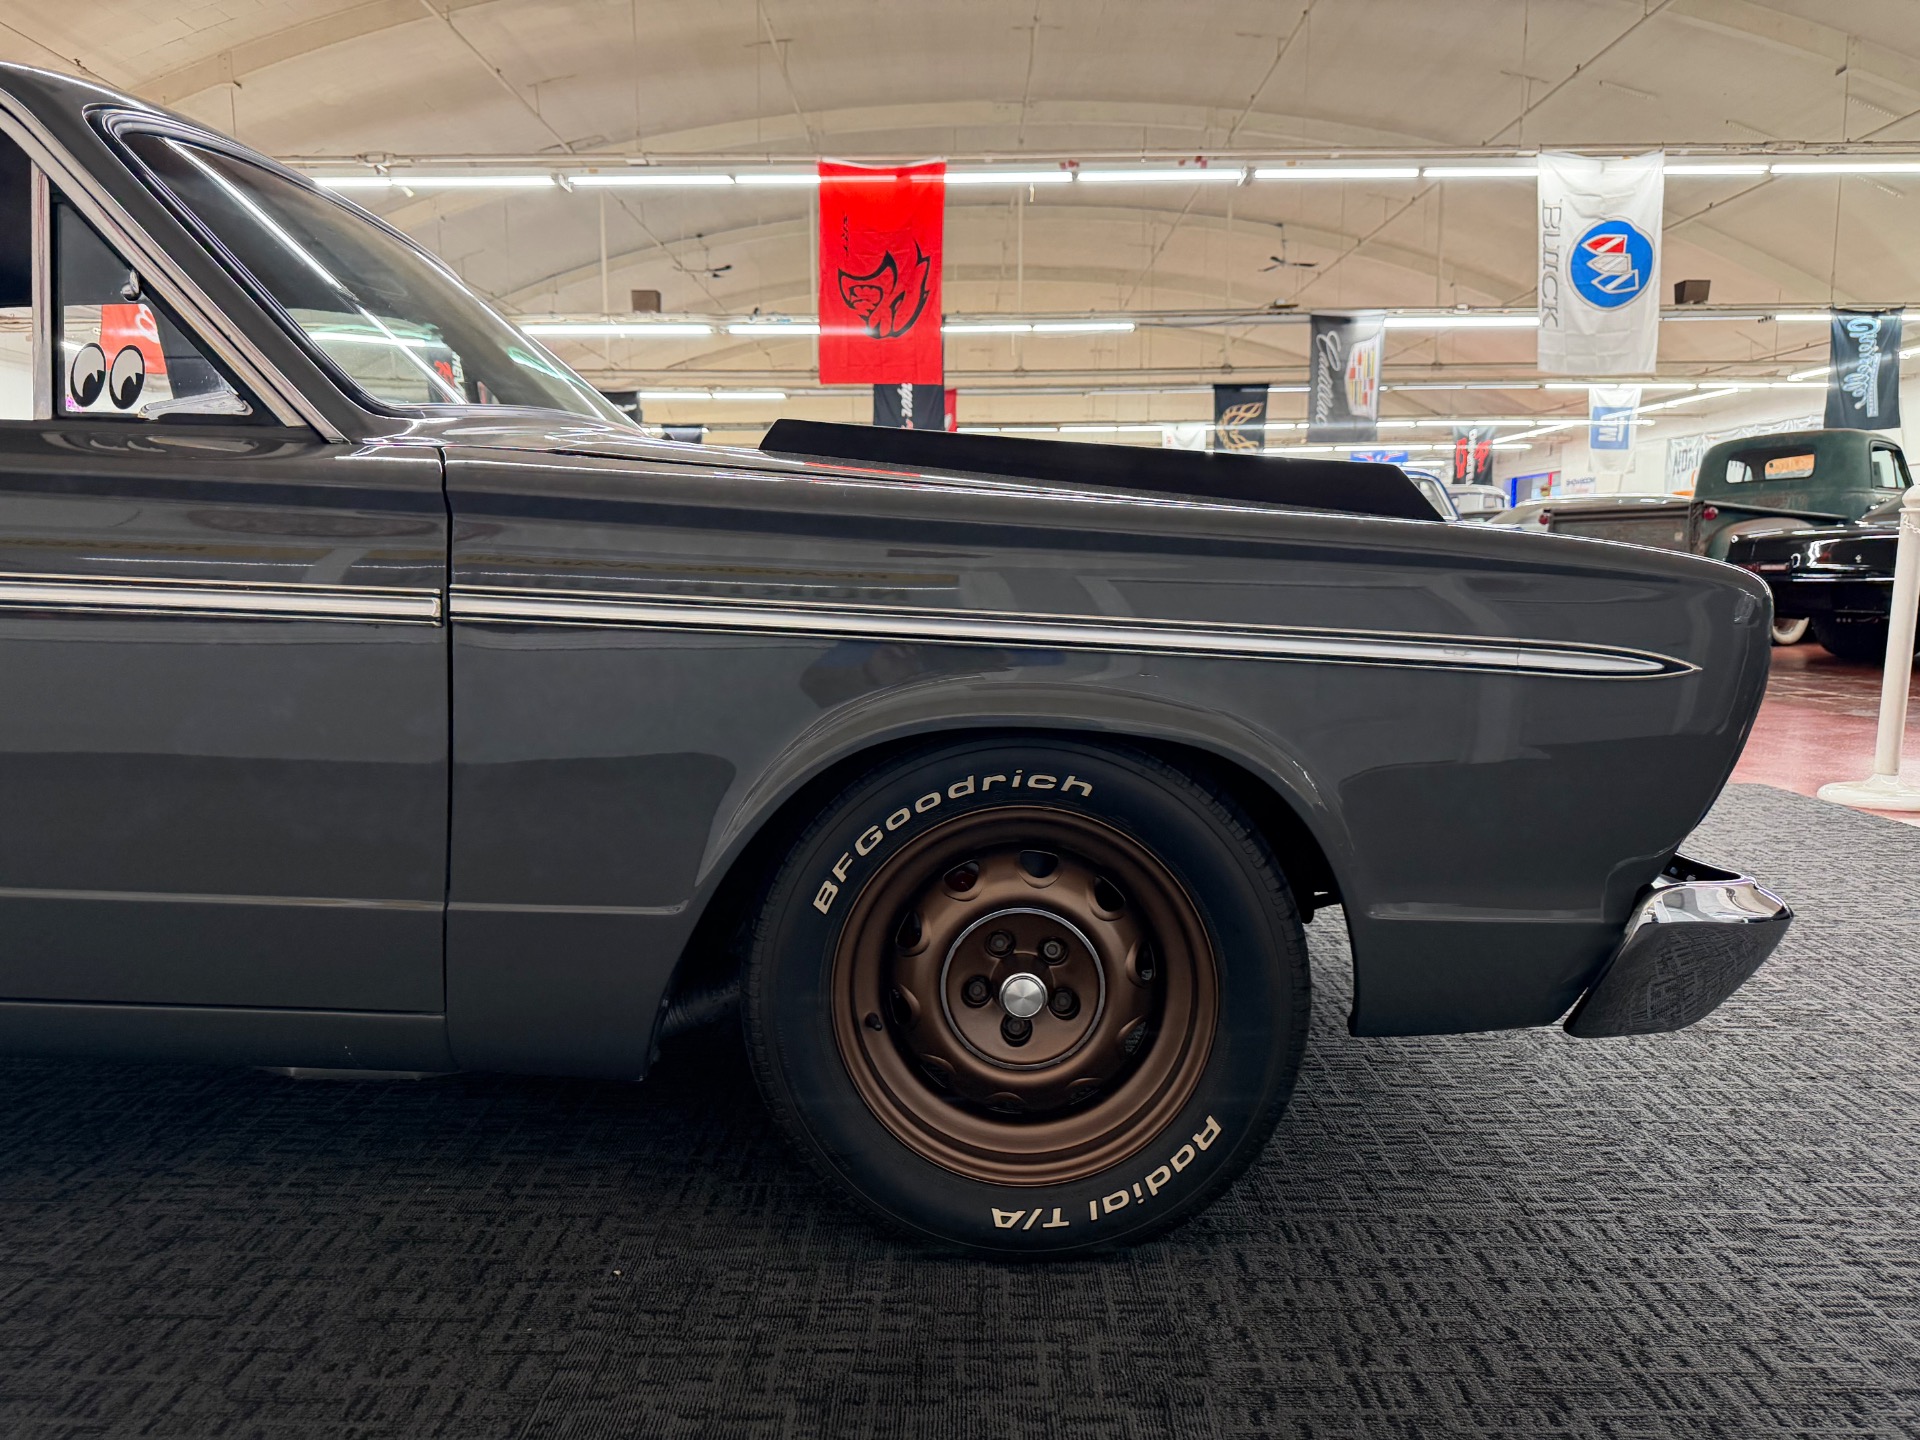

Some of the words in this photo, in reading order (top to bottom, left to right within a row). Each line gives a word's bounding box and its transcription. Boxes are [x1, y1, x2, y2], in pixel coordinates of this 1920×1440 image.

[1541, 198, 1562, 328] BUICK
[1315, 330, 1342, 427] Cadillac
[812, 769, 1093, 915] BFGoodrich
[990, 1206, 1071, 1231] T/A
[1088, 1114, 1223, 1222] Radial
